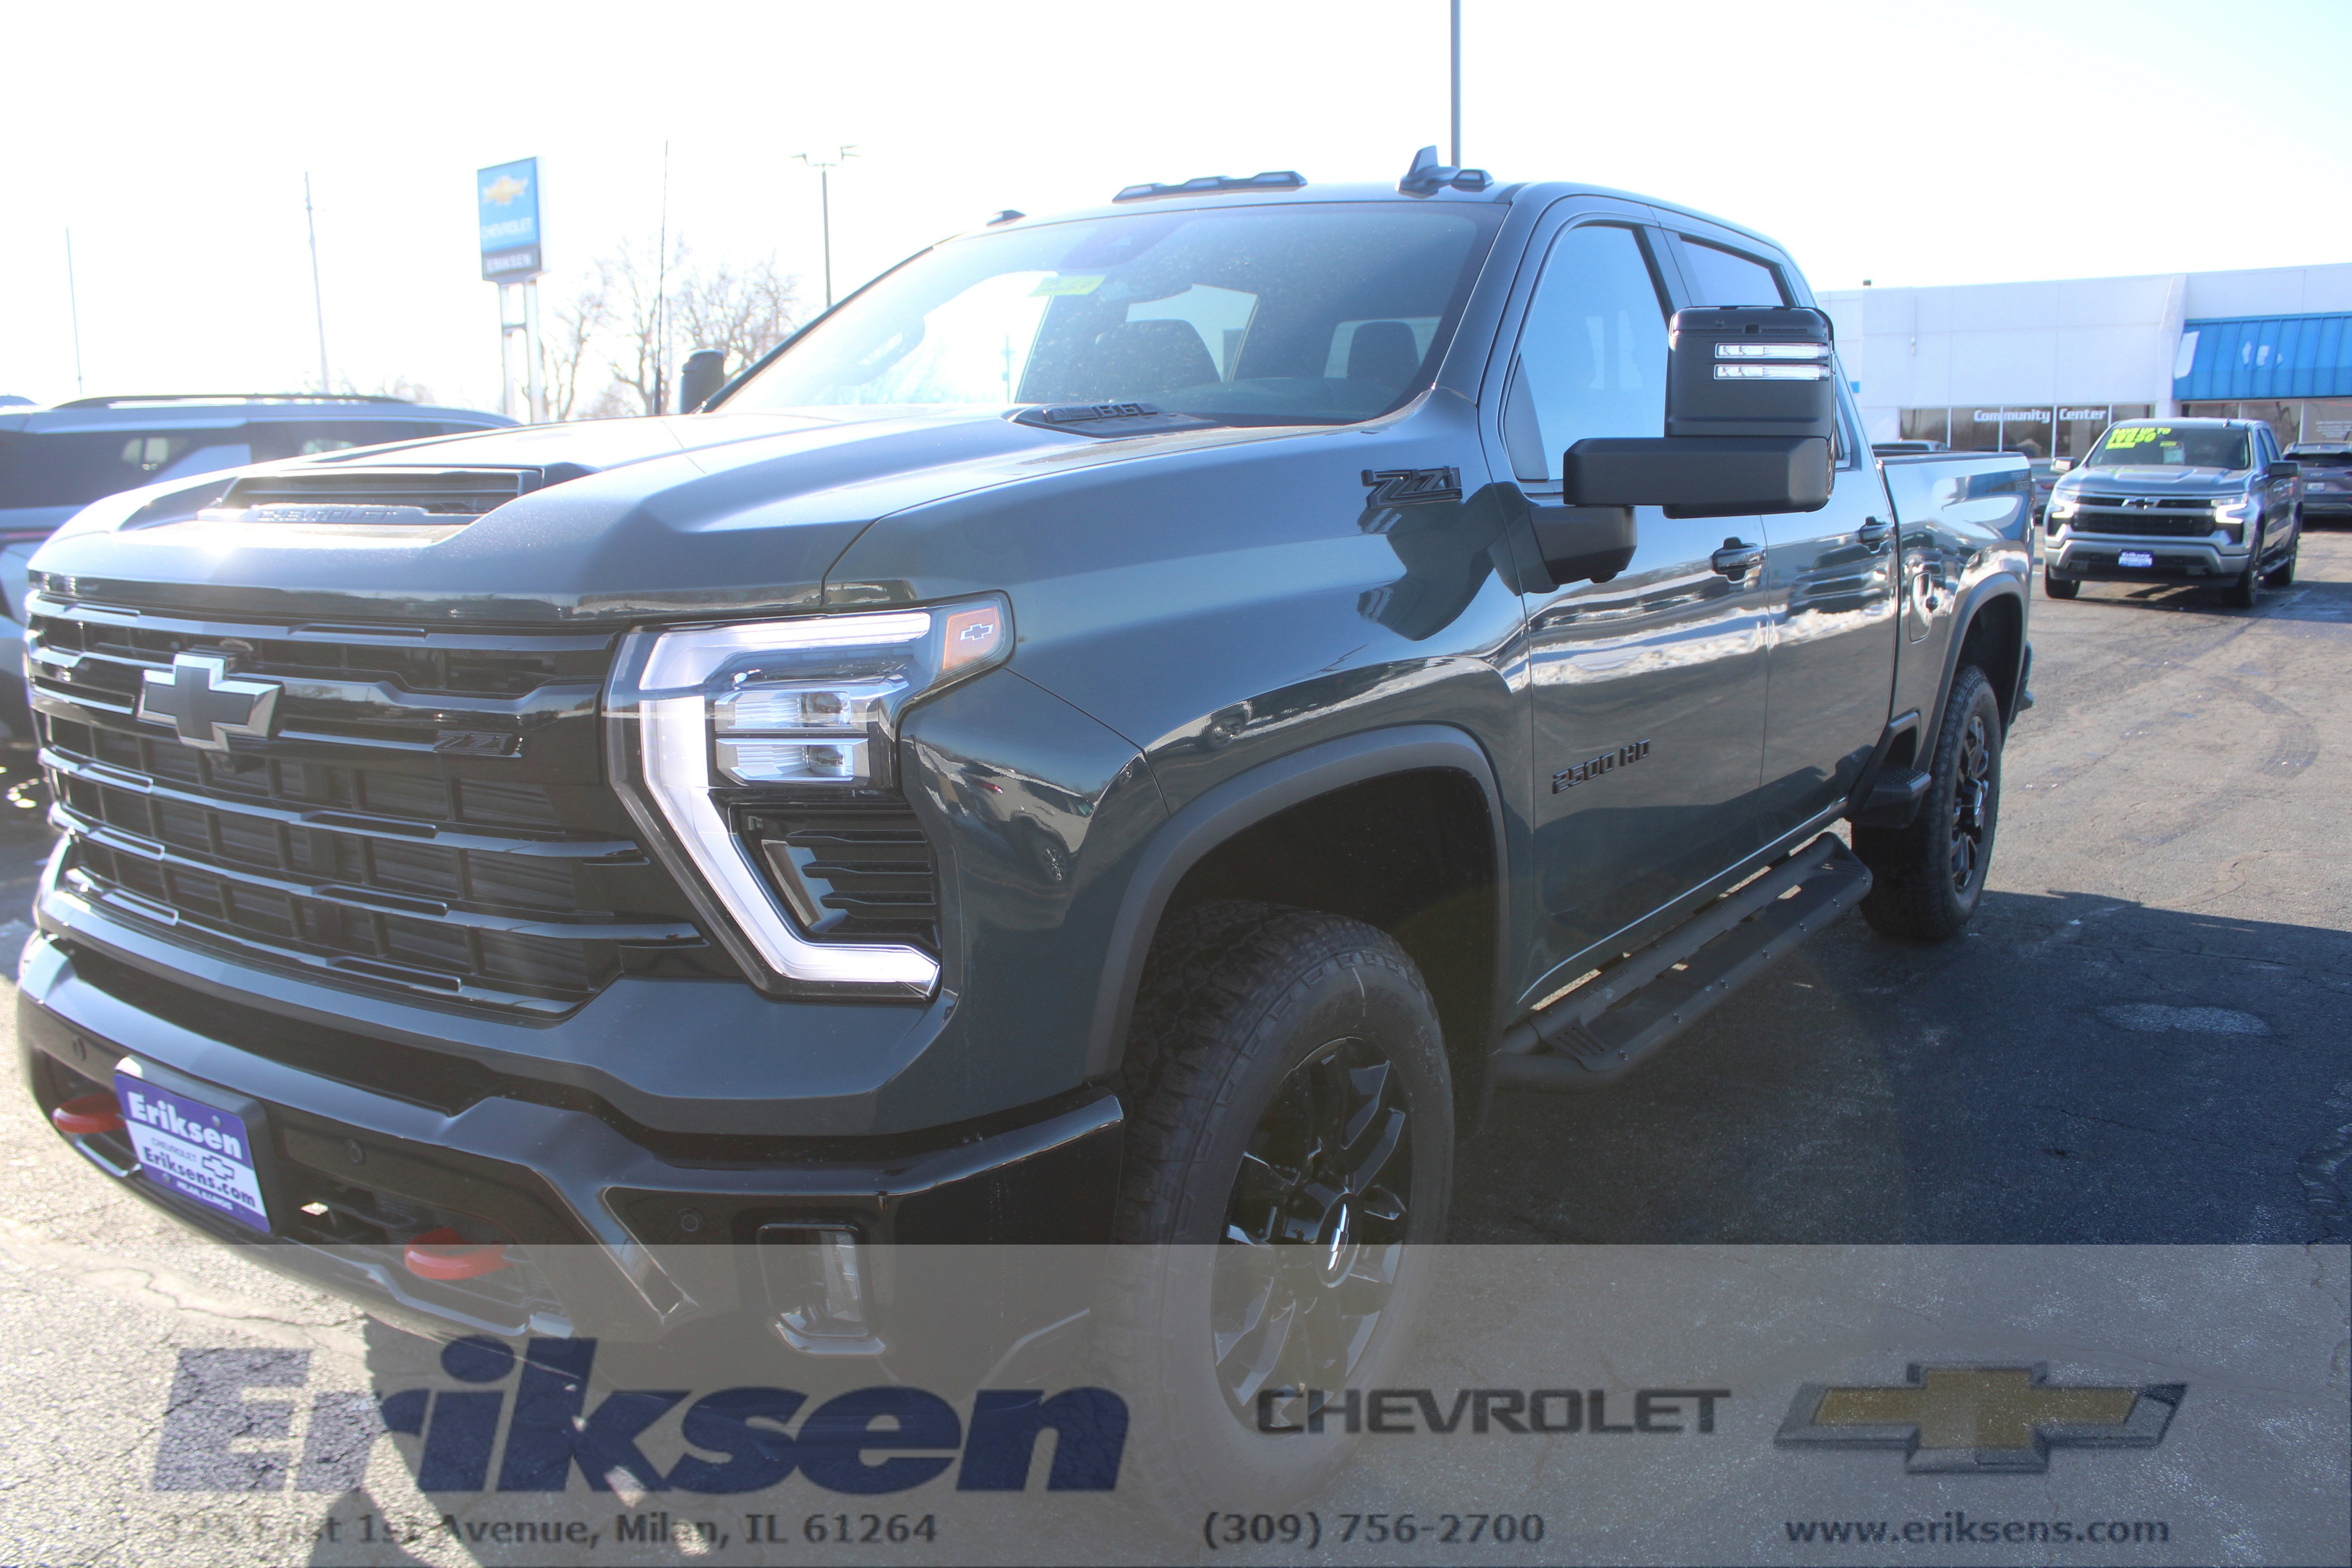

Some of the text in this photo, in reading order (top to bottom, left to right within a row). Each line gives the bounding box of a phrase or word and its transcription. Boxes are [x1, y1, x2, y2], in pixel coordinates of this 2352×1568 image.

[487, 252, 532, 273] ERIKSEN
[1973, 408, 2106, 424] Community Center
[1361, 466, 1463, 509] Z71
[257, 510, 397, 521] CHEVROLET
[434, 729, 513, 755] Z71
[1552, 739, 1651, 794] 2500 HD
[127, 1091, 243, 1160] Eriksen
[143, 1146, 256, 1208] Eriksens.com
